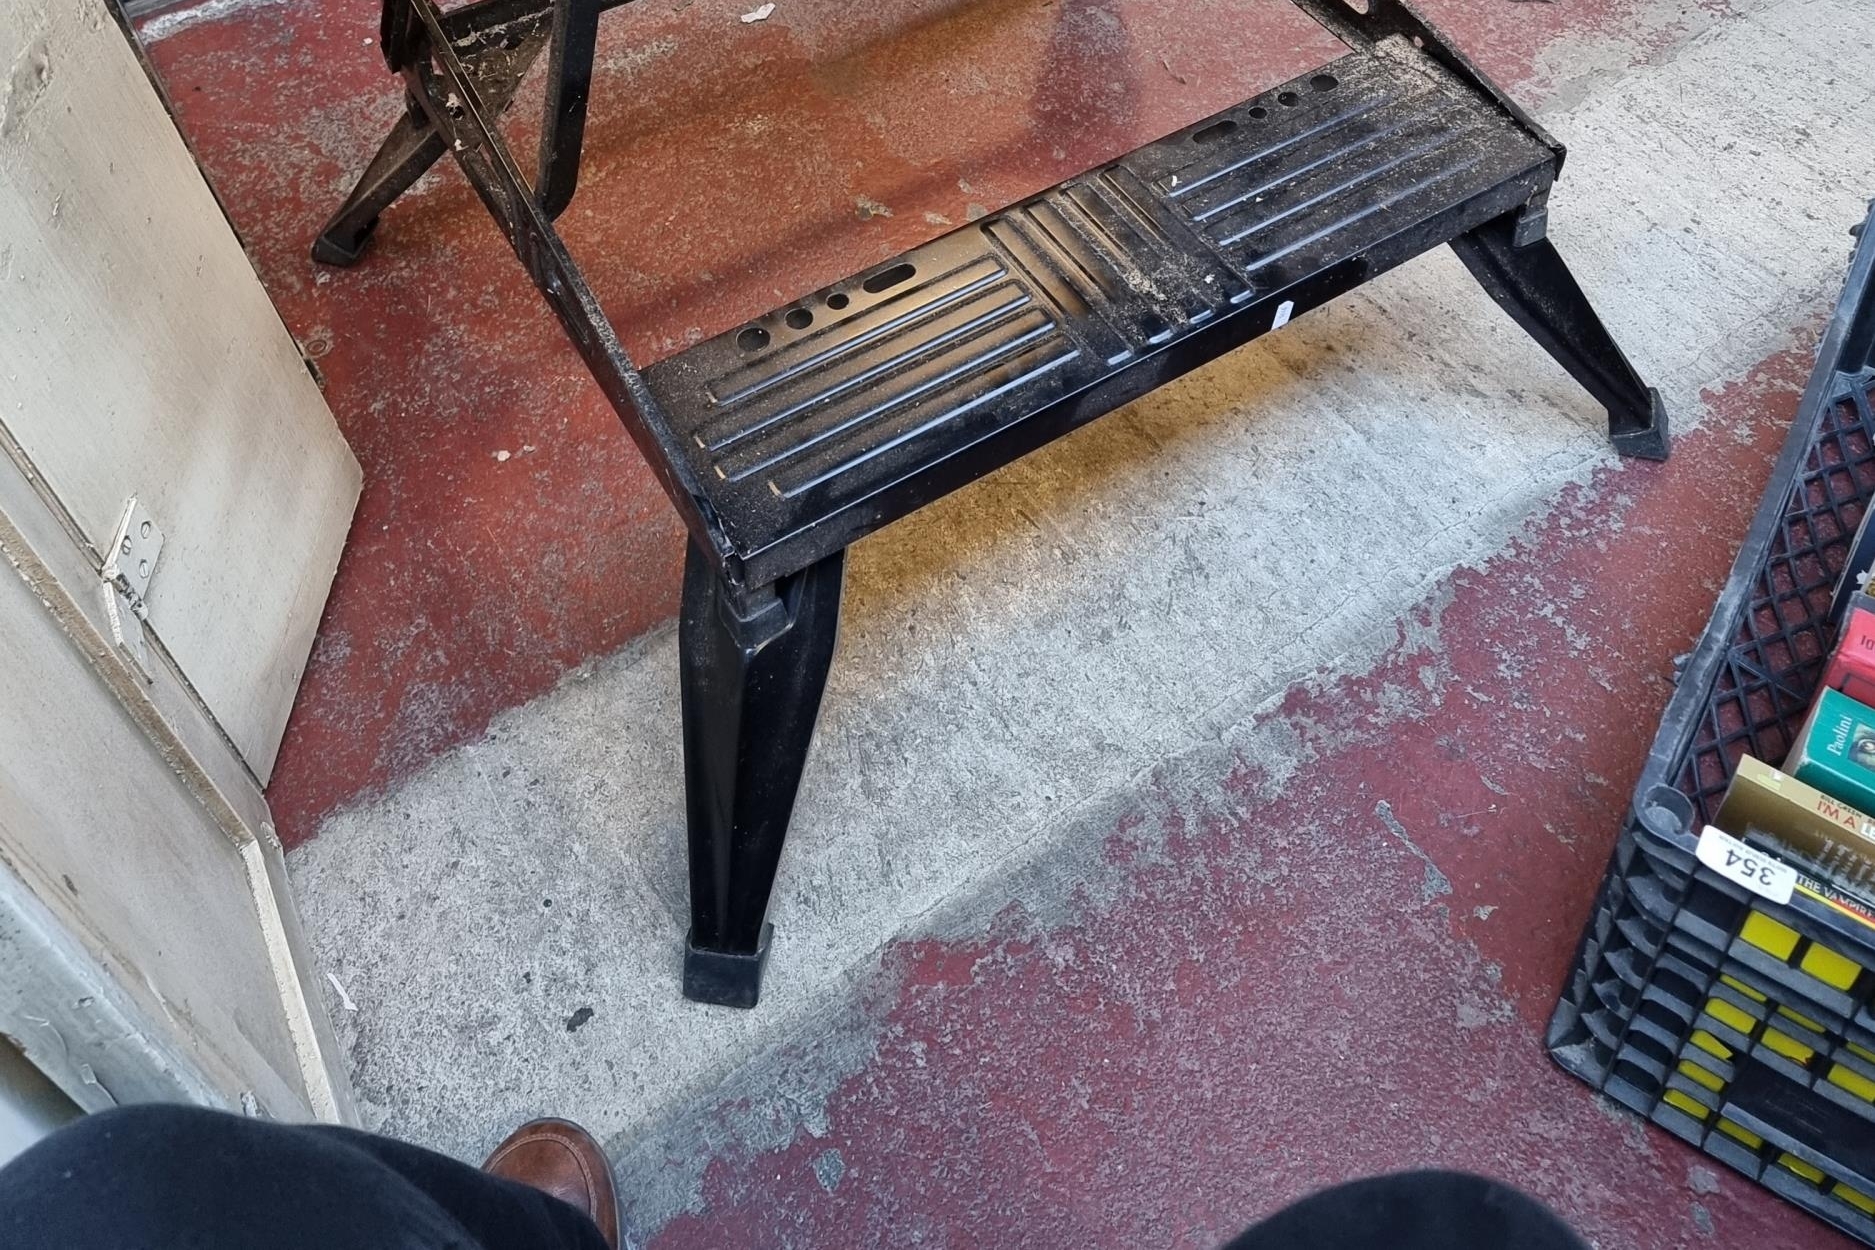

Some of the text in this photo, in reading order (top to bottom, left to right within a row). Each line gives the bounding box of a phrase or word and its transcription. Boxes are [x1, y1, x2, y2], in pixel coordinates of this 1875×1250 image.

[1826, 715, 1853, 757] Paolini
[1843, 815, 1857, 830] A
[1725, 848, 1776, 887] 354
[1798, 876, 1821, 894] THE
